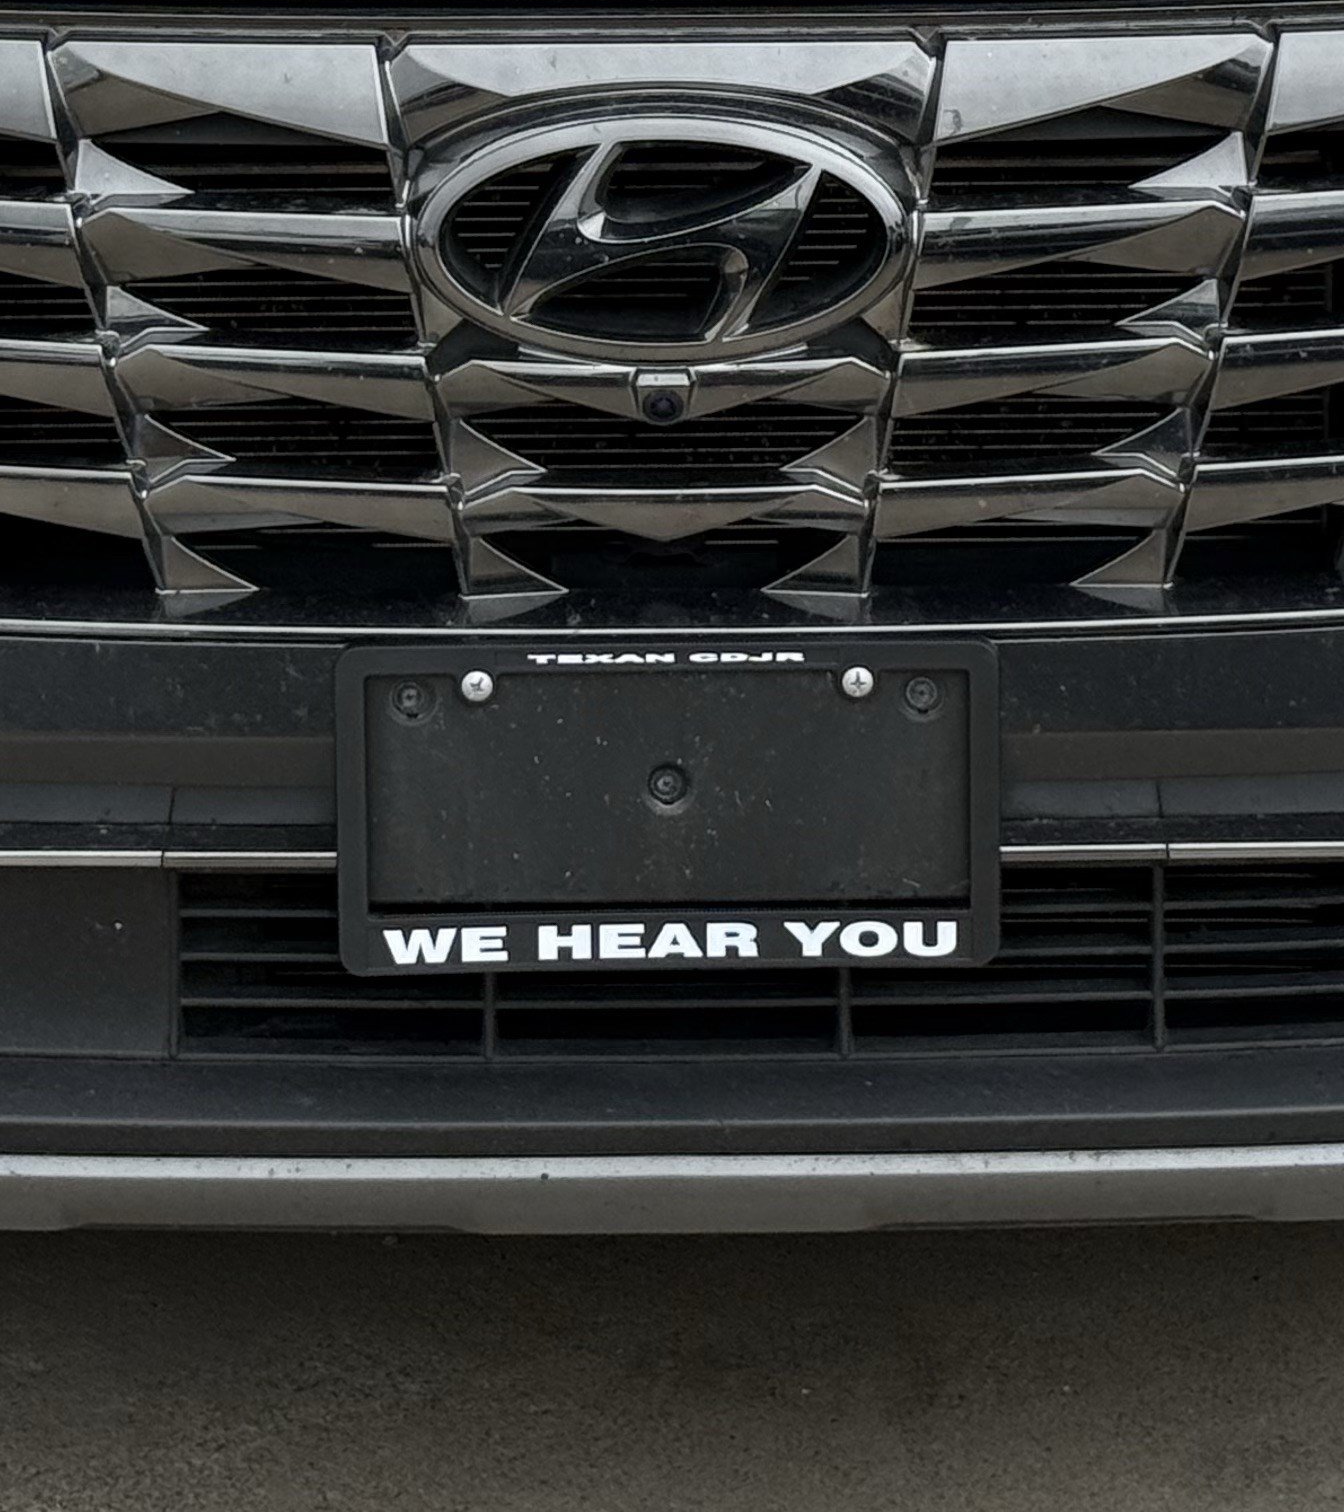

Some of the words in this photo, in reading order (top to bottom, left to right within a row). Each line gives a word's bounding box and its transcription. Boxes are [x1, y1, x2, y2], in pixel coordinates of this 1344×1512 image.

[527, 652, 676, 665] TEXAN
[688, 651, 805, 664] CDJR
[382, 925, 509, 965] WE
[537, 921, 760, 961] HEAR
[782, 919, 958, 958] YOU
